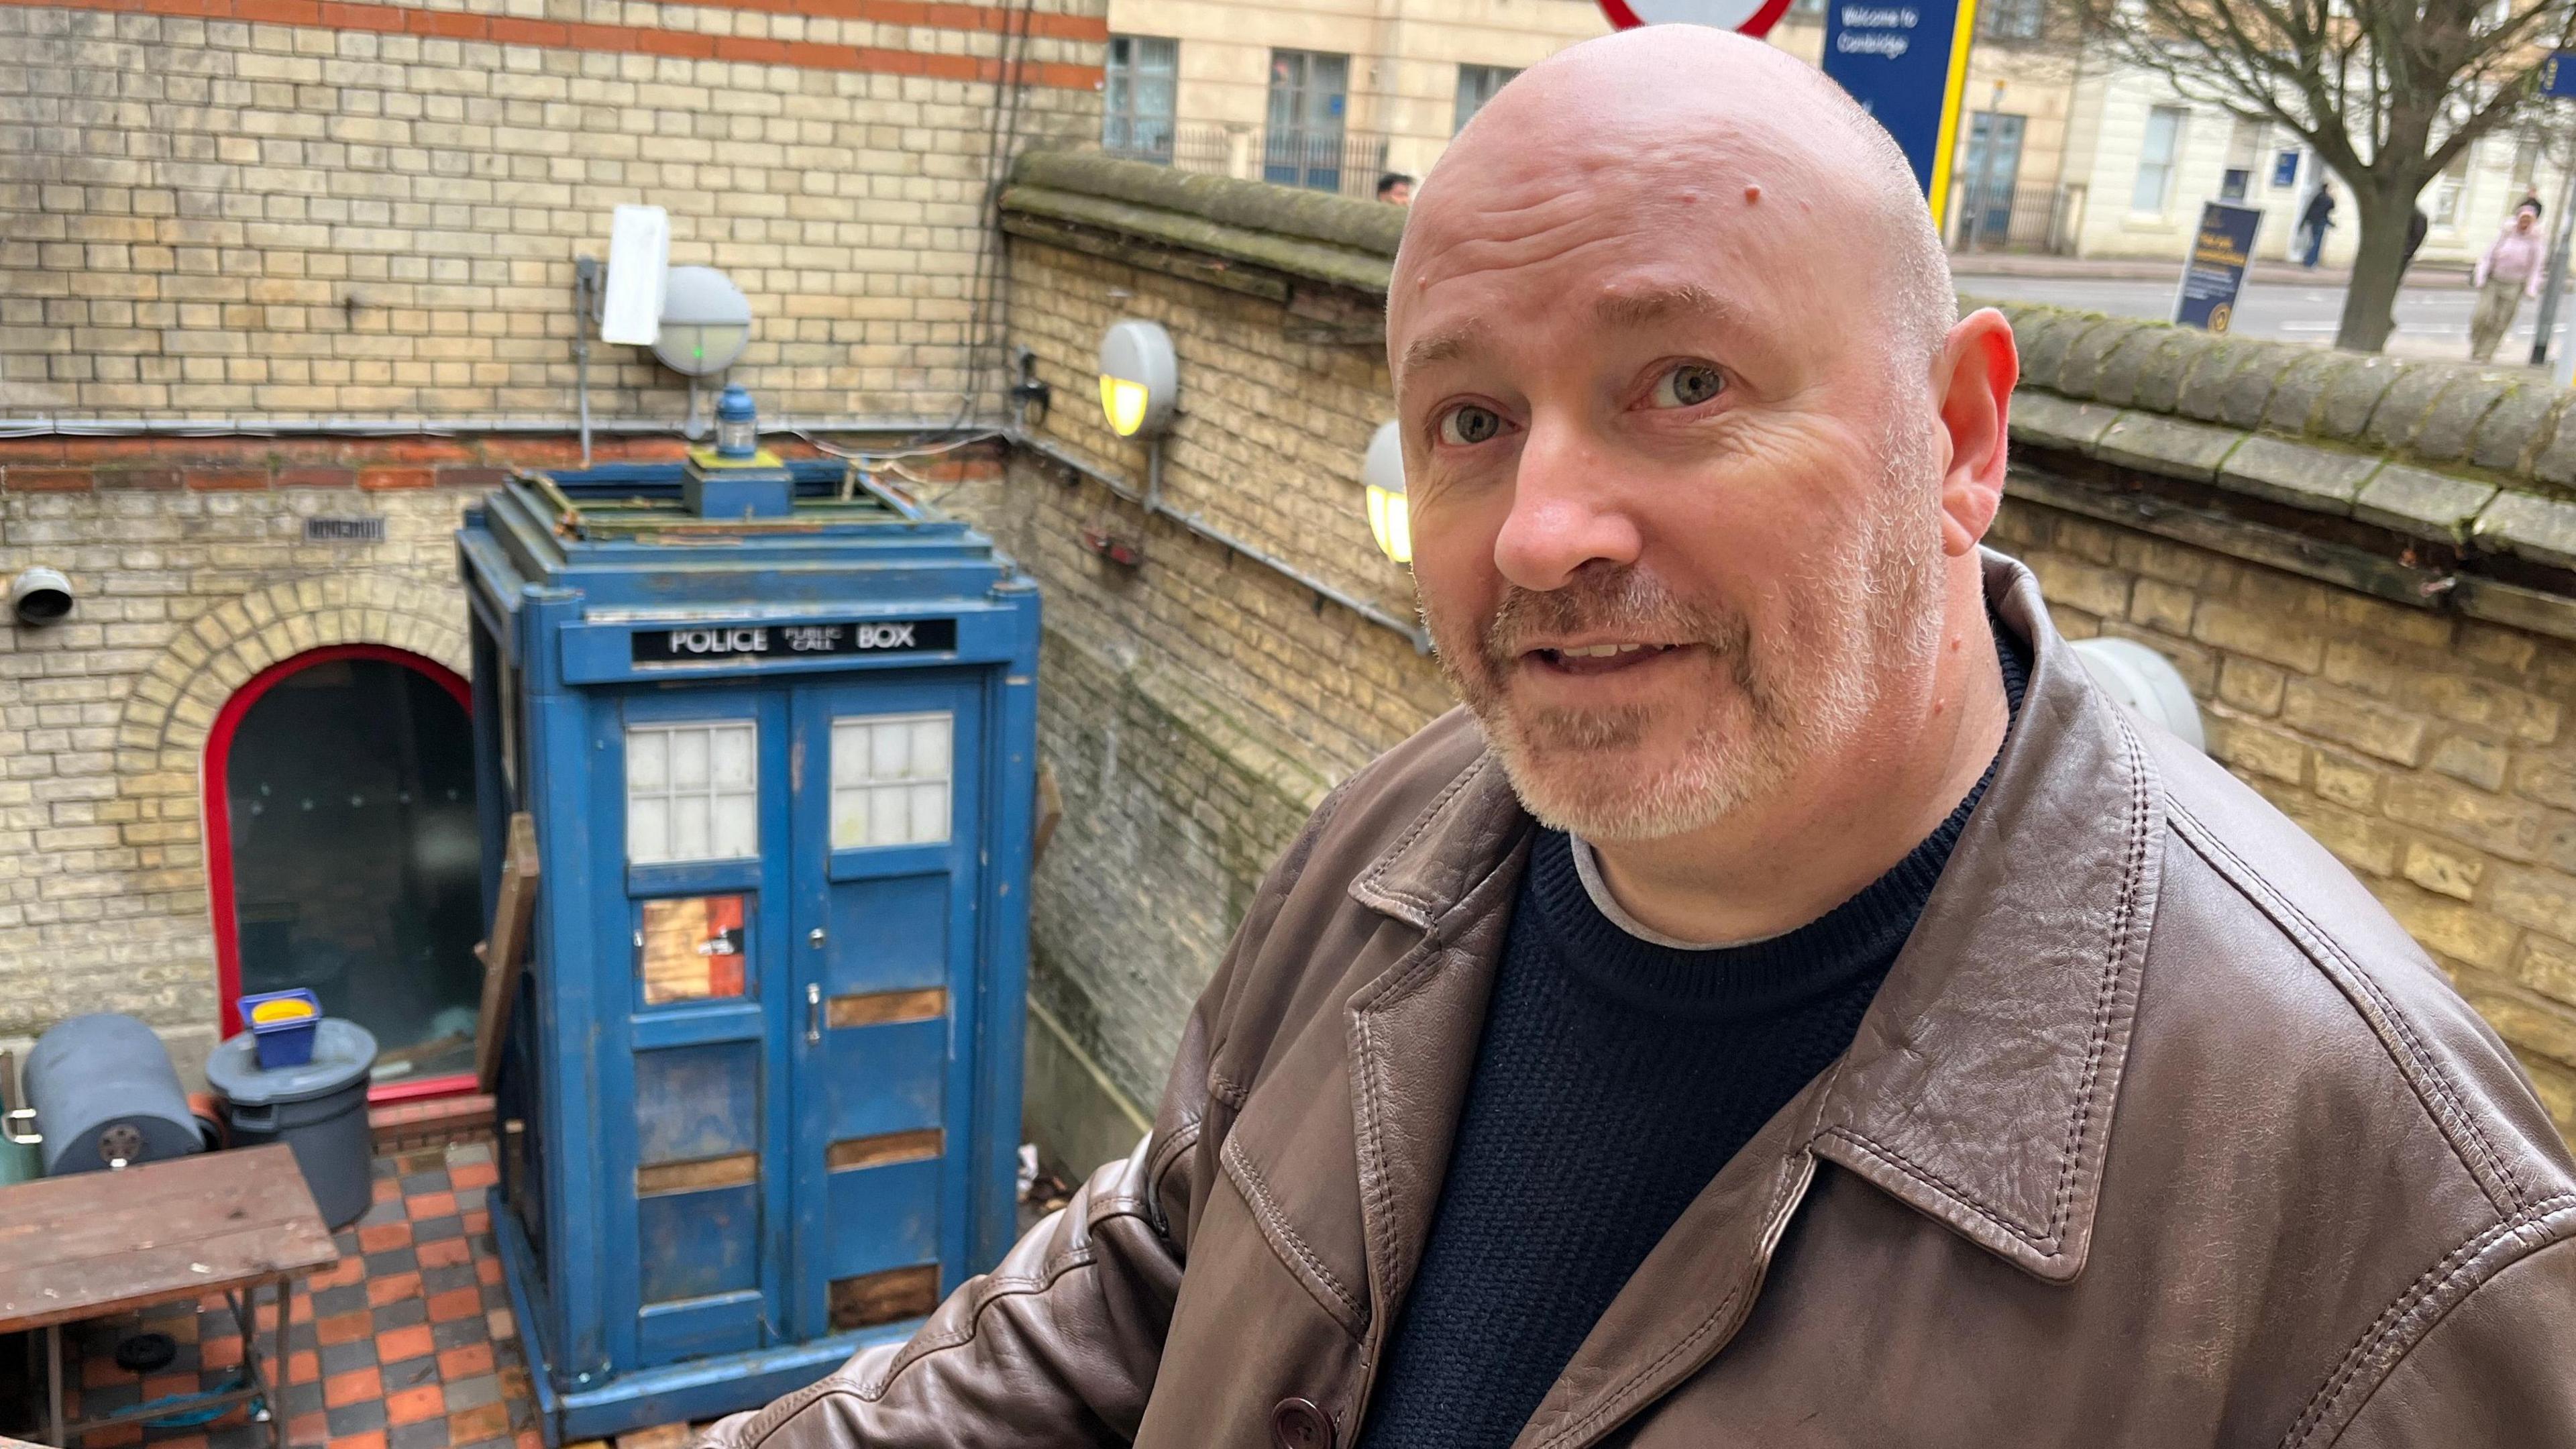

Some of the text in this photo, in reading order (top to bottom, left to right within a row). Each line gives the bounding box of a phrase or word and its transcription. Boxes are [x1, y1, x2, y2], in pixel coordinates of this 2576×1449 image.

[1841, 5, 1918, 28] Welcome to
[1837, 32, 1908, 59] Cambridge
[671, 629, 768, 653] POLICE
[785, 627, 841, 639] PUBLIC
[792, 637, 835, 651] CALL
[859, 624, 915, 649] BOX
